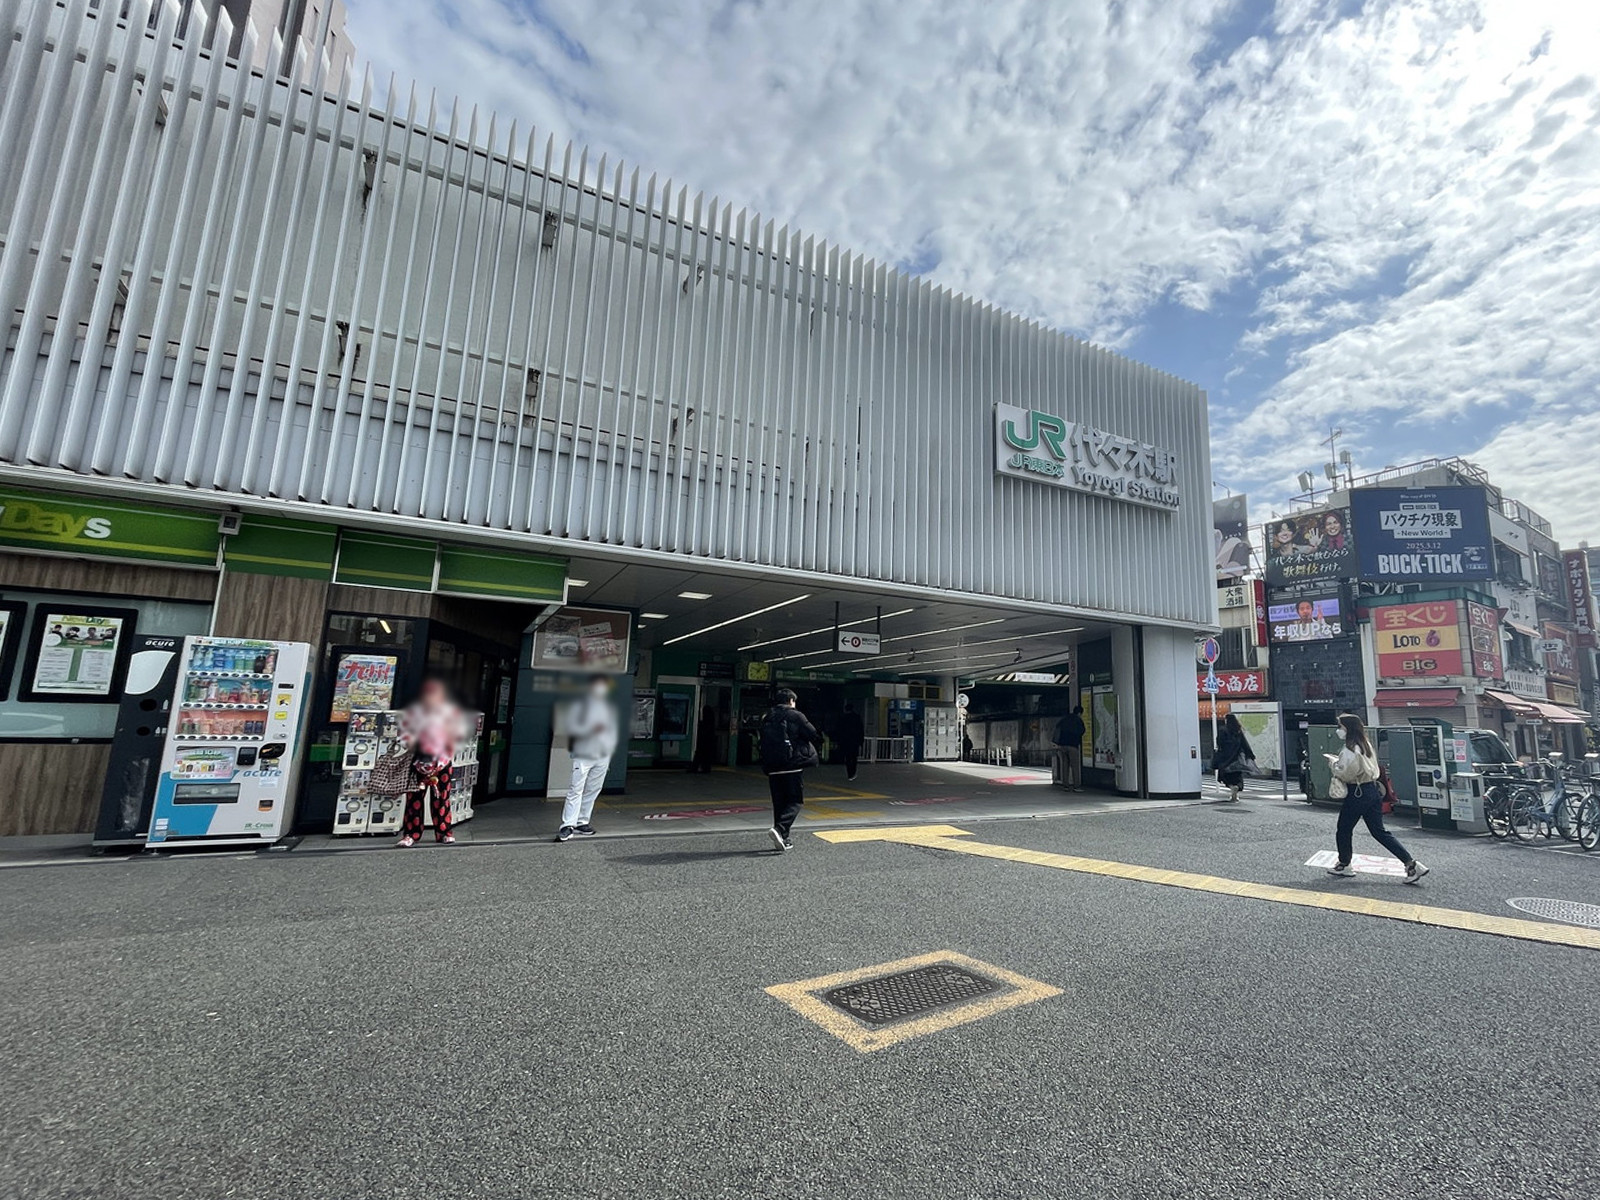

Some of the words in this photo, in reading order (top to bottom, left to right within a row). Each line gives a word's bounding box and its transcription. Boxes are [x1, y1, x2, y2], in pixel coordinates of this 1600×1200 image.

[1003, 410, 1066, 460] JR
[1070, 423, 1178, 485] 代々木駅
[1008, 452, 1066, 479] JR東日本
[1072, 463, 1125, 496] Yoyogi
[1128, 480, 1180, 507] Station
[0, 501, 112, 539] Days
[1384, 512, 1458, 527] バクチク現象
[1406, 542, 1441, 550] 2025.3.12
[1275, 548, 1349, 566] 代々木で飲むなら
[1378, 553, 1464, 574] BUCK-TICK
[1225, 587, 1243, 597] 大衆
[1225, 597, 1244, 607] 酒場
[1383, 605, 1447, 628] 宝くじ
[1274, 622, 1342, 640] 年収UPなら
[1392, 634, 1421, 648] LOTO
[1425, 629, 1440, 648] 6
[144, 640, 175, 648] acure
[1402, 655, 1437, 671] BIG
[243, 769, 282, 778] acure
